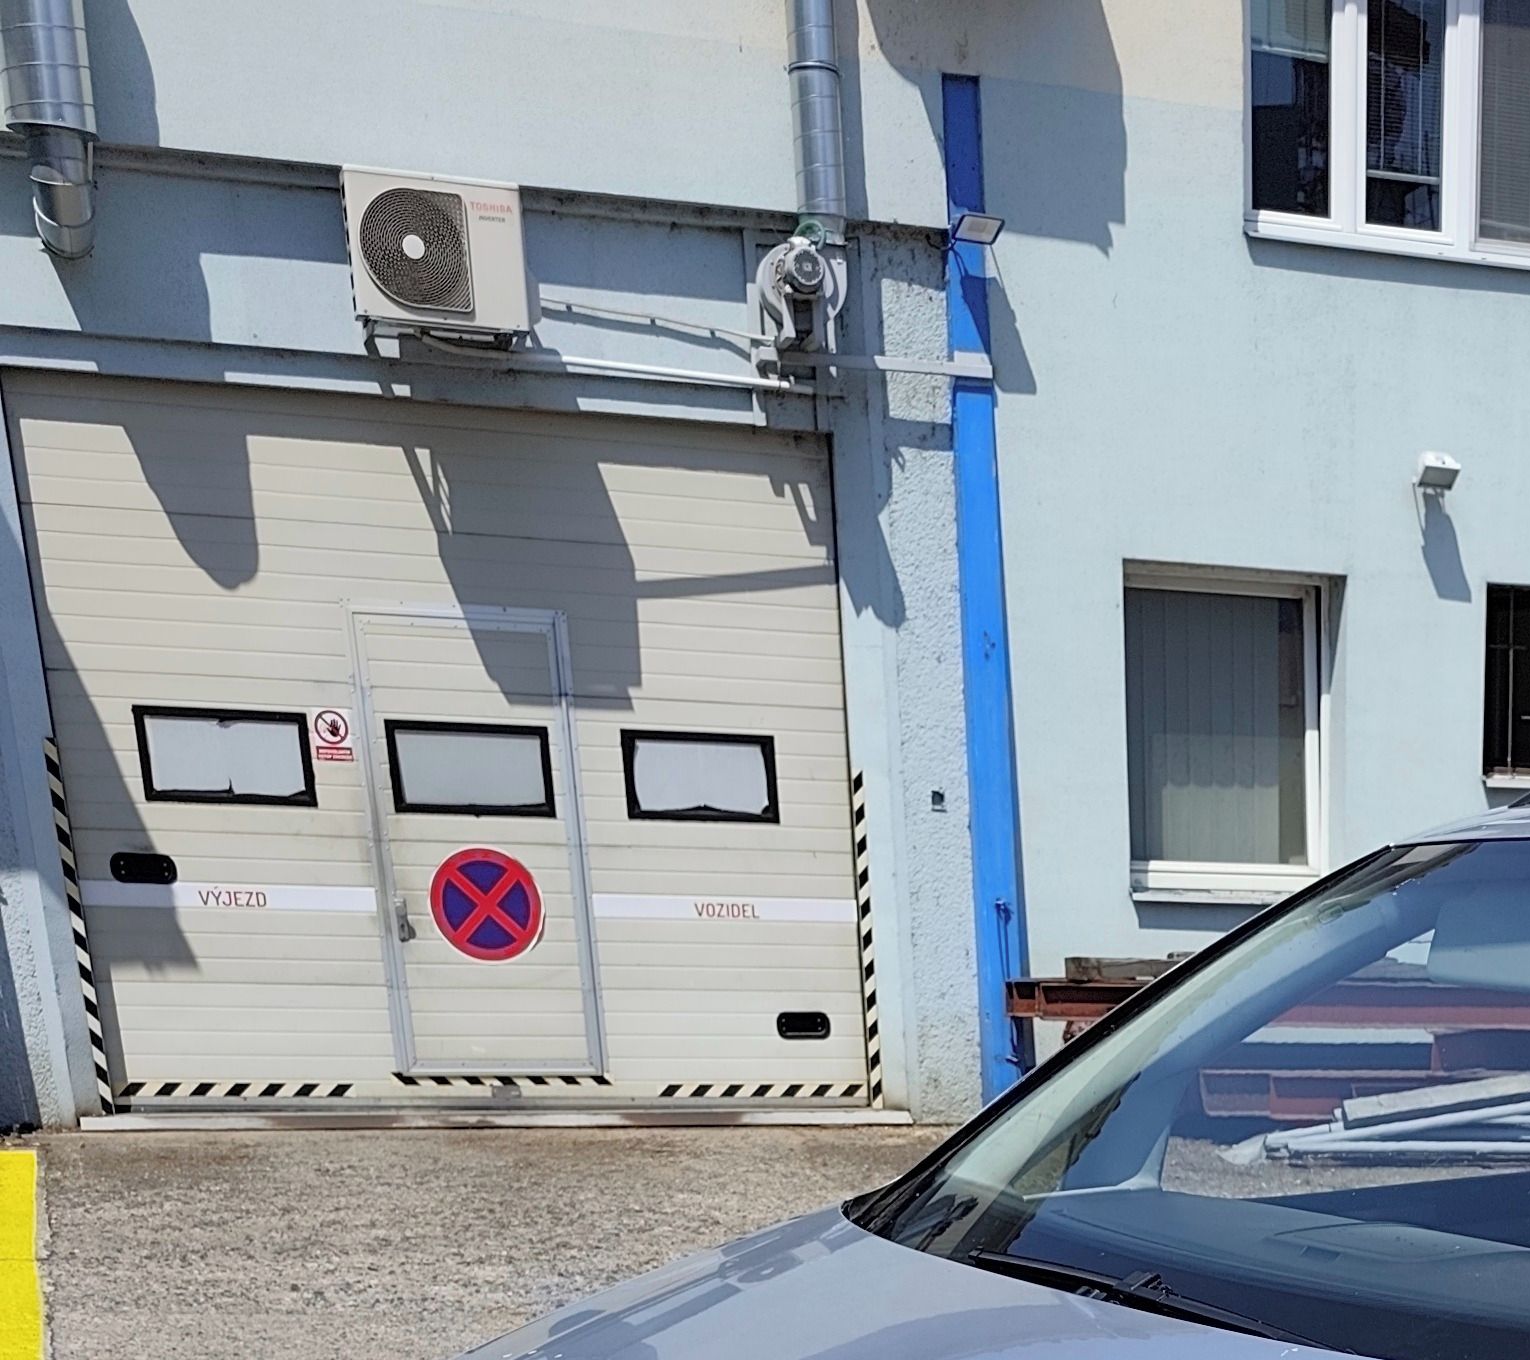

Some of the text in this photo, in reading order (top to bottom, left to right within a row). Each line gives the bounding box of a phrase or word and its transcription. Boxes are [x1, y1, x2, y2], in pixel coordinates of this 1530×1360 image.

[470, 201, 513, 213] TOSHIBA
[478, 215, 506, 223] INVERTER
[198, 886, 267, 908] VÝJEZD
[694, 902, 760, 919] VOZIDEL
